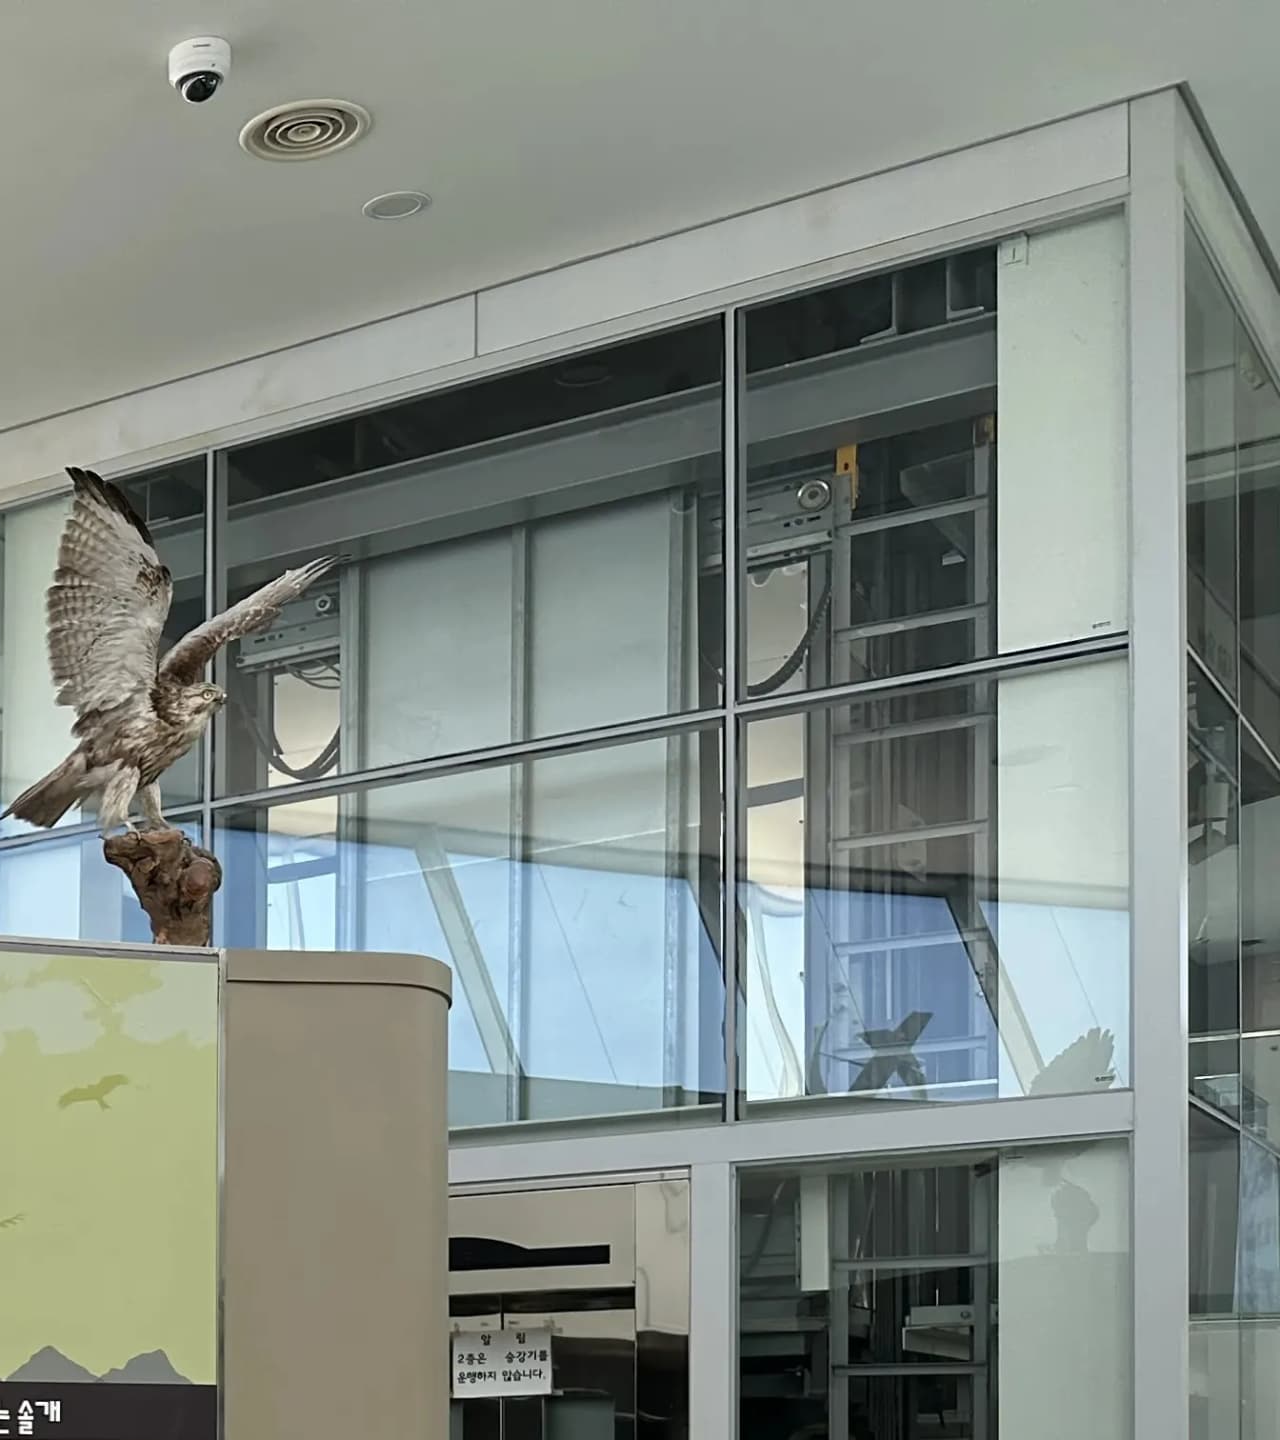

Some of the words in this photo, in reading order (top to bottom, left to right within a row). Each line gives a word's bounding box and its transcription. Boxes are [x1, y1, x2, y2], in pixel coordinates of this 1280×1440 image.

[505, 1350, 548, 1363] 승강기를
[458, 1371, 496, 1383] 운행하지
[18, 1400, 60, 1434] 솔개
